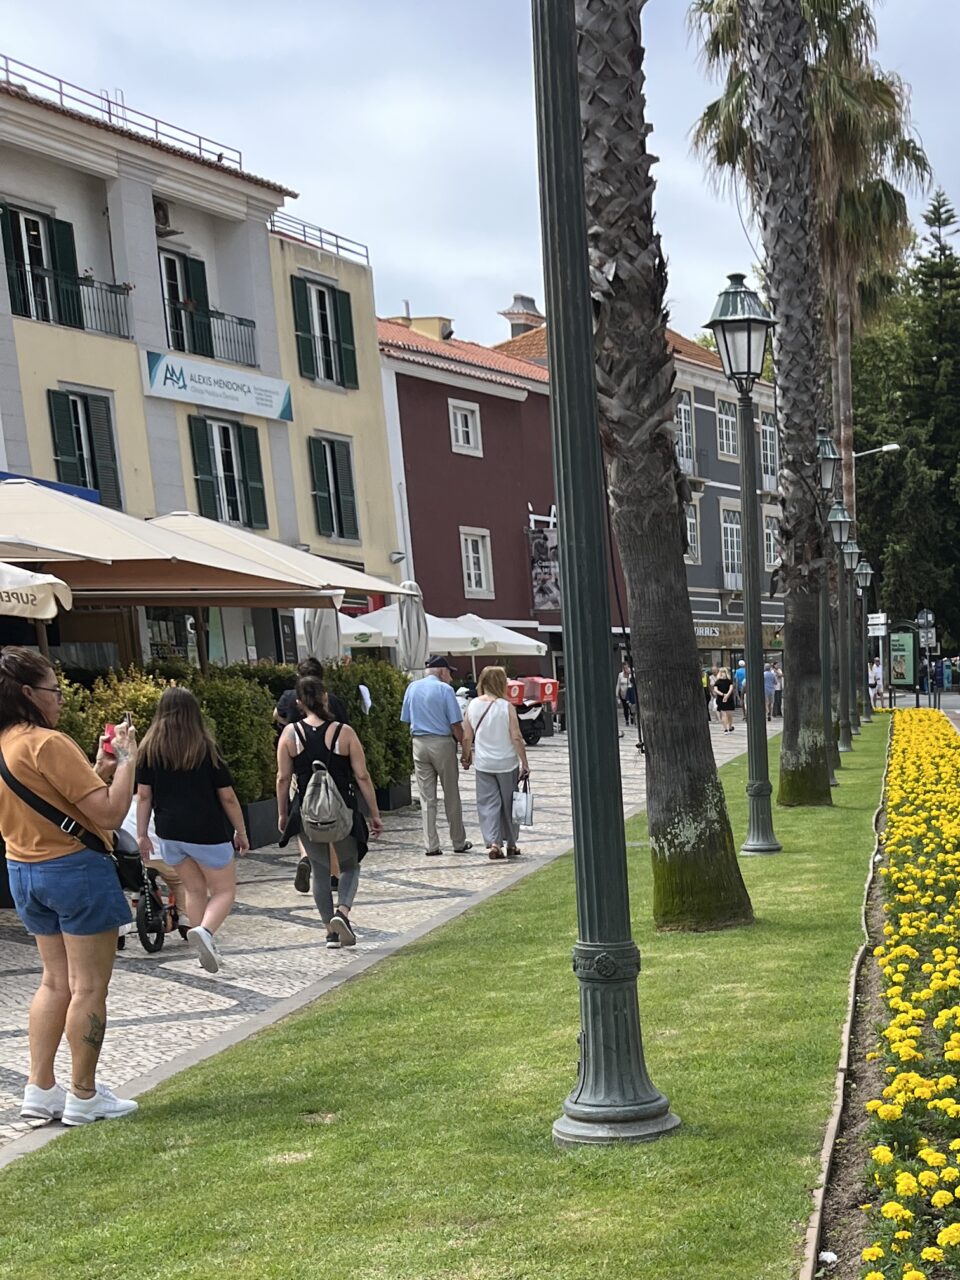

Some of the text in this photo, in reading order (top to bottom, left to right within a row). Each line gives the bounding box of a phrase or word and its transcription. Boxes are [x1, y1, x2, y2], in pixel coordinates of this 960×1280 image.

[189, 374, 213, 386] ALEXIS
[212, 379, 252, 397] MENDONÇA
[694, 626, 720, 637] ORRES
